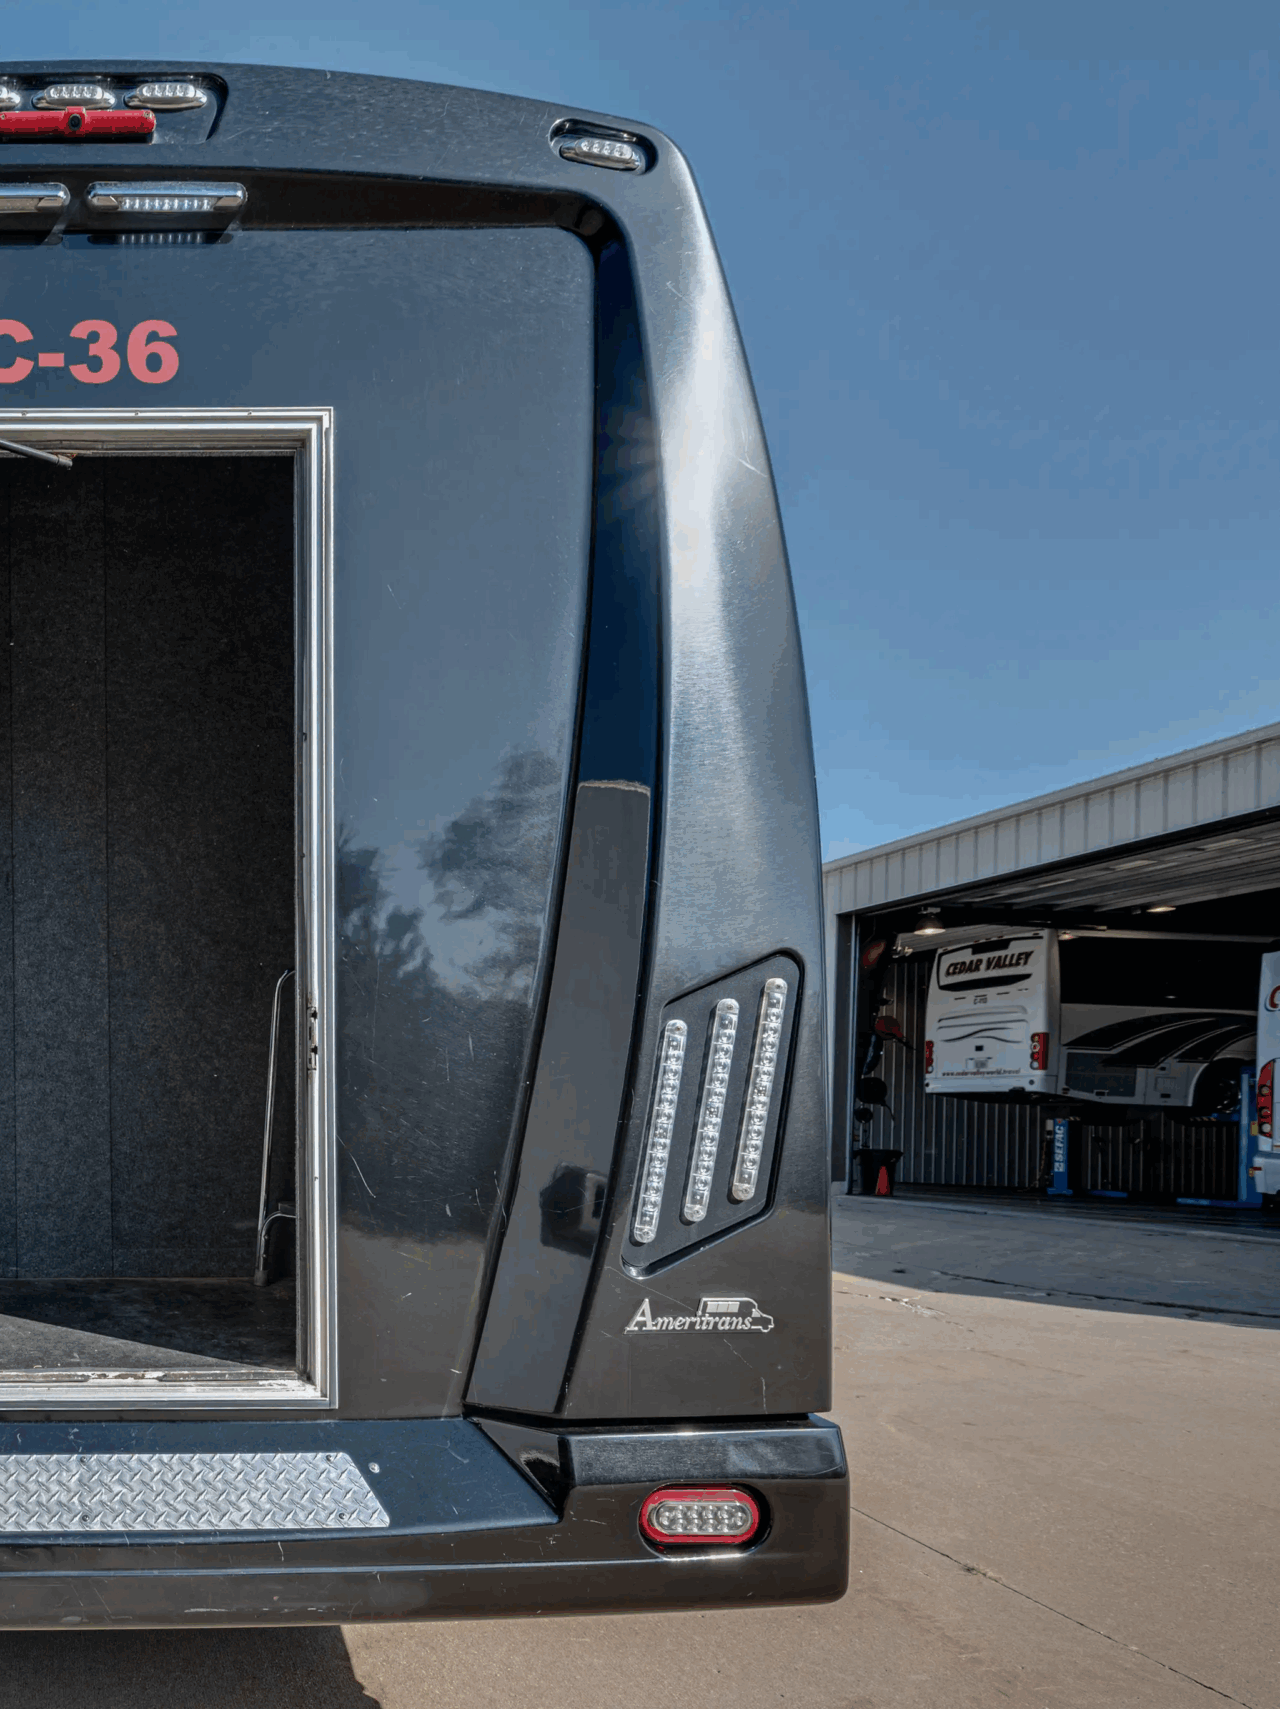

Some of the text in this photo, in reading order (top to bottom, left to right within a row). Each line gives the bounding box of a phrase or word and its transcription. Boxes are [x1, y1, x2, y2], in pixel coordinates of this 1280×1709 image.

[945, 950, 1035, 977] CEDAR VALLEY
[1055, 1125, 1065, 1162] SEFAC
[624, 1298, 753, 1332] Ameritrans
